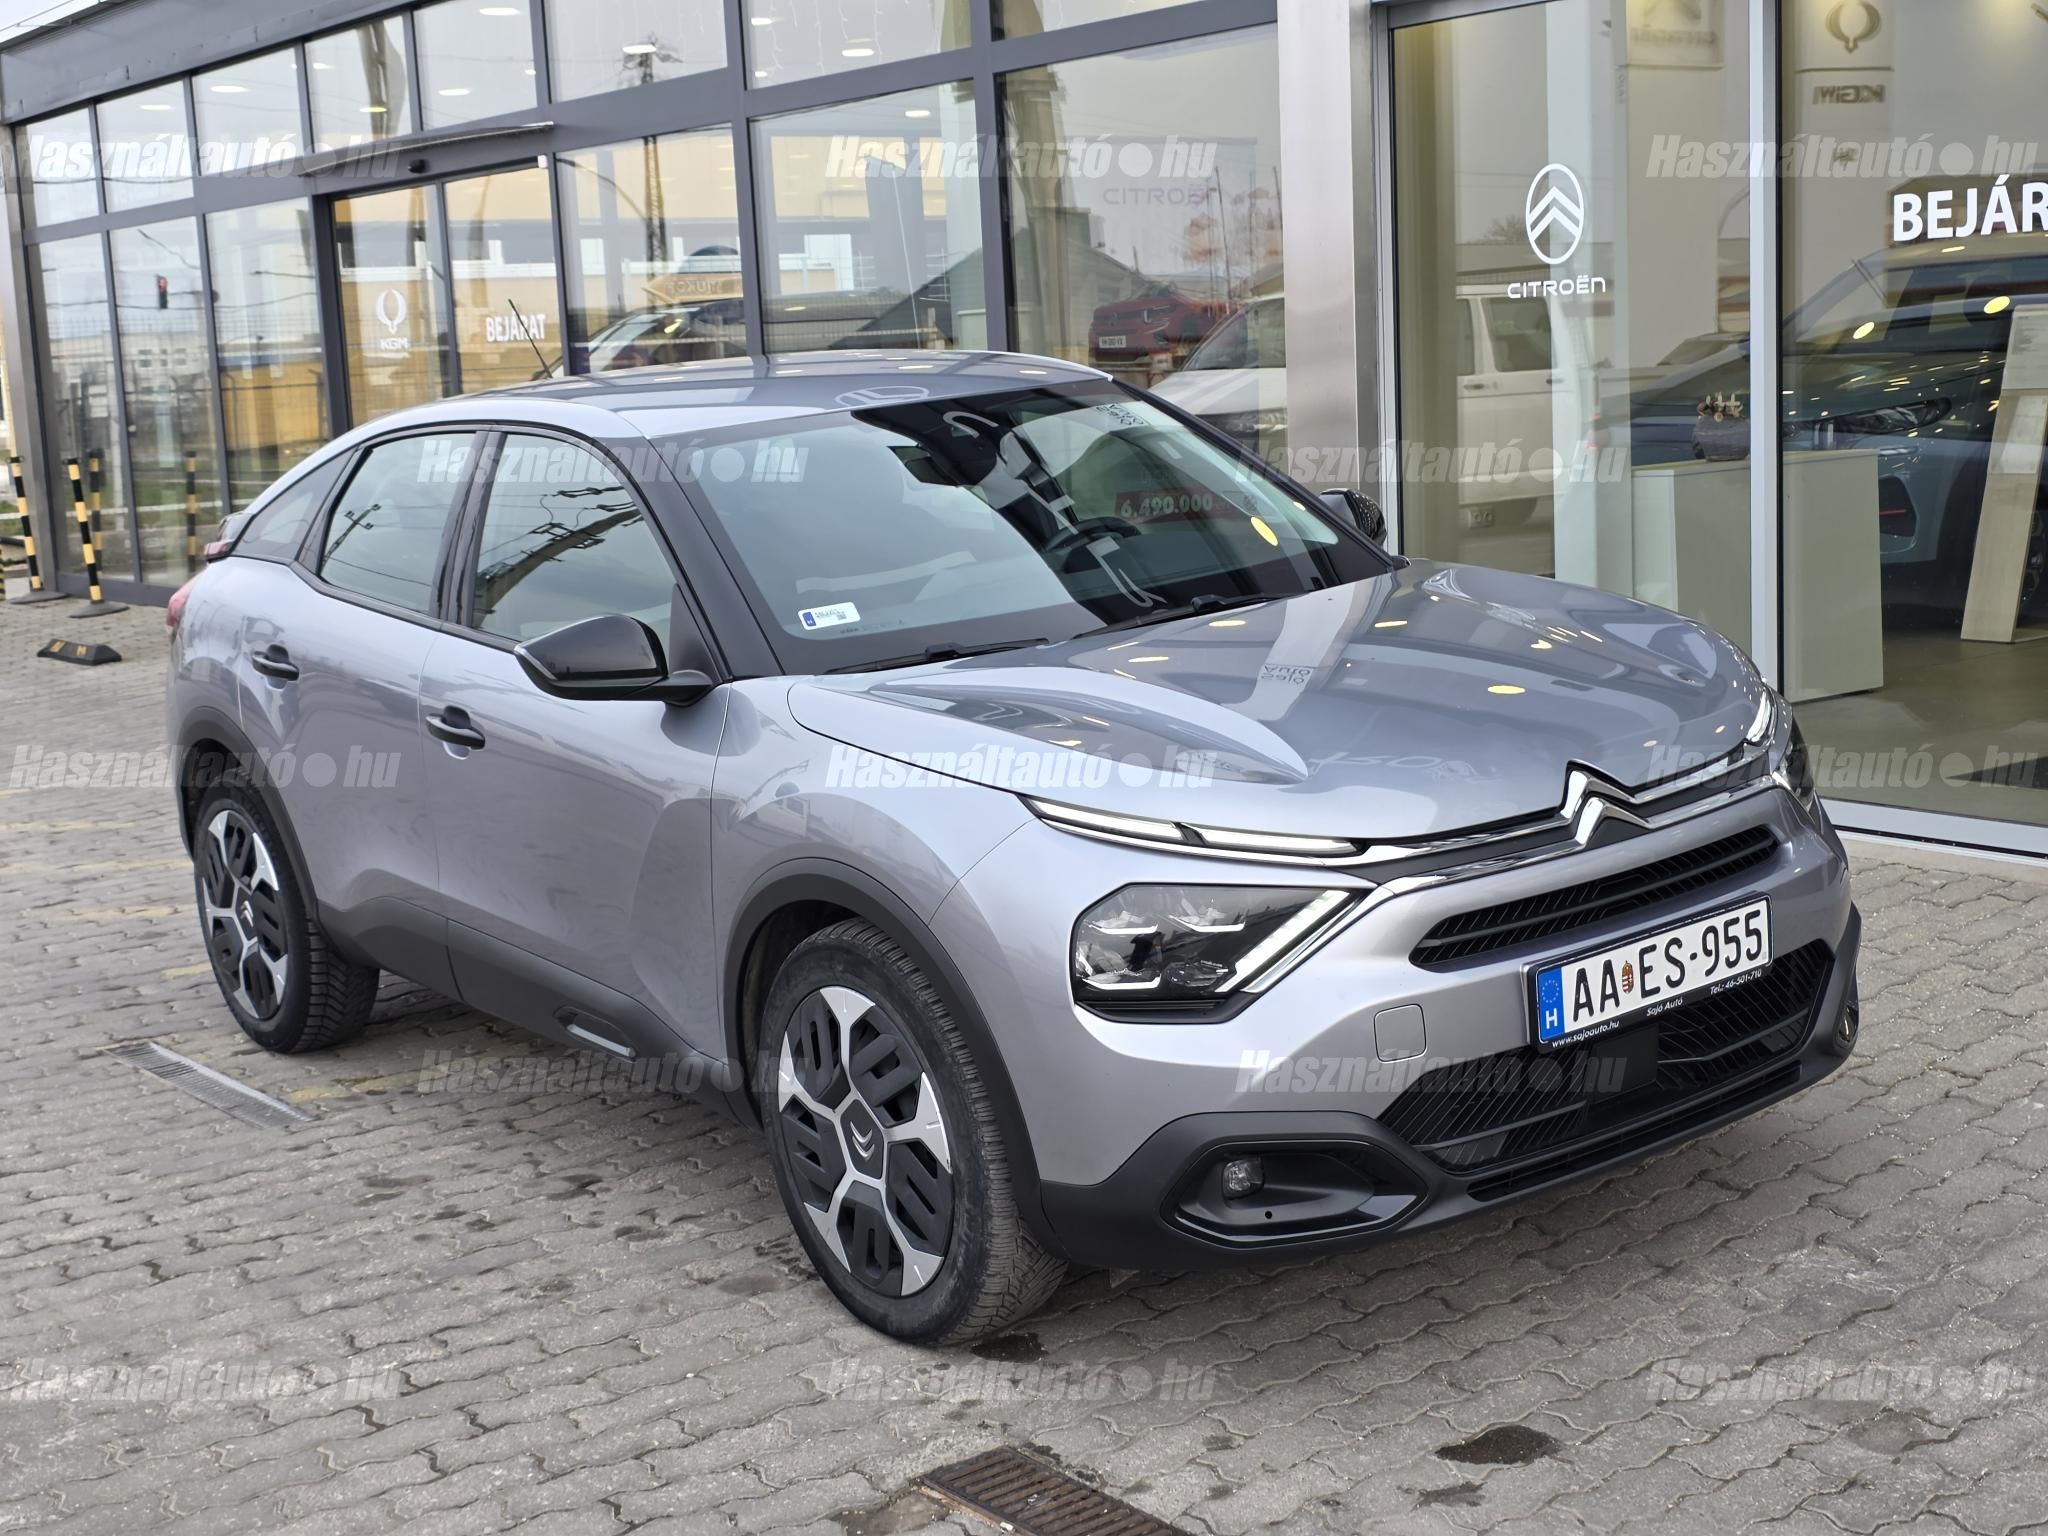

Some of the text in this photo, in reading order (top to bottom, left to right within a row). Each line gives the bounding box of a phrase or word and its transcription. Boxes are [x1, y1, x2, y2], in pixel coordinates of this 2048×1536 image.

[1893, 173, 2048, 241] BEJÁR
[1507, 274, 1606, 299] CITROËN
[486, 313, 547, 343] BEJÁRAT
[1120, 494, 1213, 517] 6.490.000
[1545, 1008, 1559, 1029] H
[1551, 1020, 1620, 1048] www.sajoauto.hu
